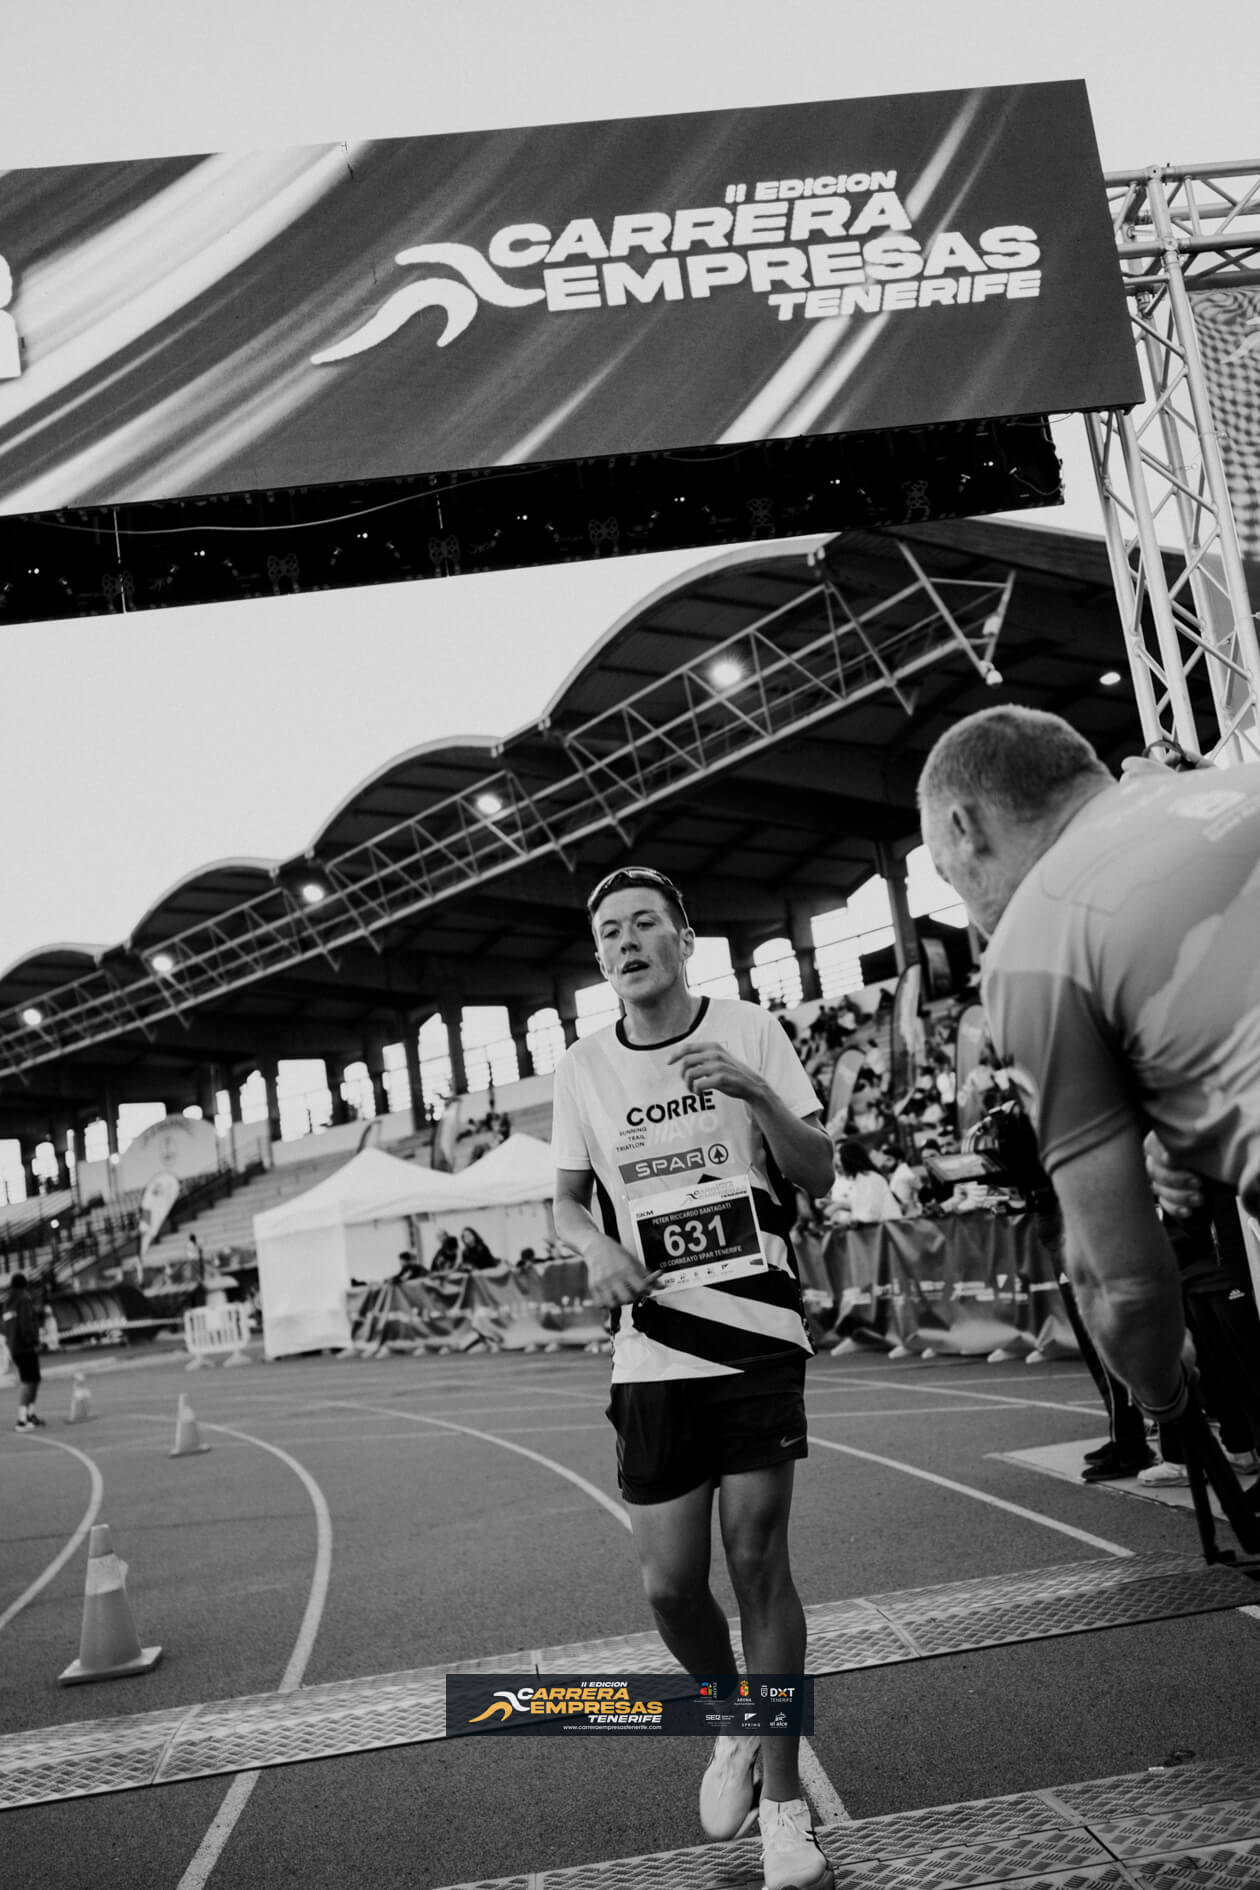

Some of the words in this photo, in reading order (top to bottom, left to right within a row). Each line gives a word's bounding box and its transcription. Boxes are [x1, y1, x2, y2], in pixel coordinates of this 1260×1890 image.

[726, 184, 747, 203] II
[754, 170, 897, 201] EDICION
[488, 191, 912, 267] CARRERA
[543, 225, 1041, 312] EMPRESAS
[768, 270, 1042, 321] TENERIFE
[626, 1090, 716, 1126] CORRE
[616, 1142, 645, 1152] TRIATLON
[619, 1126, 647, 1136] RUNNING
[628, 1134, 646, 1142] TRAIL
[635, 1151, 703, 1177] SPAR
[663, 1215, 728, 1257] 631
